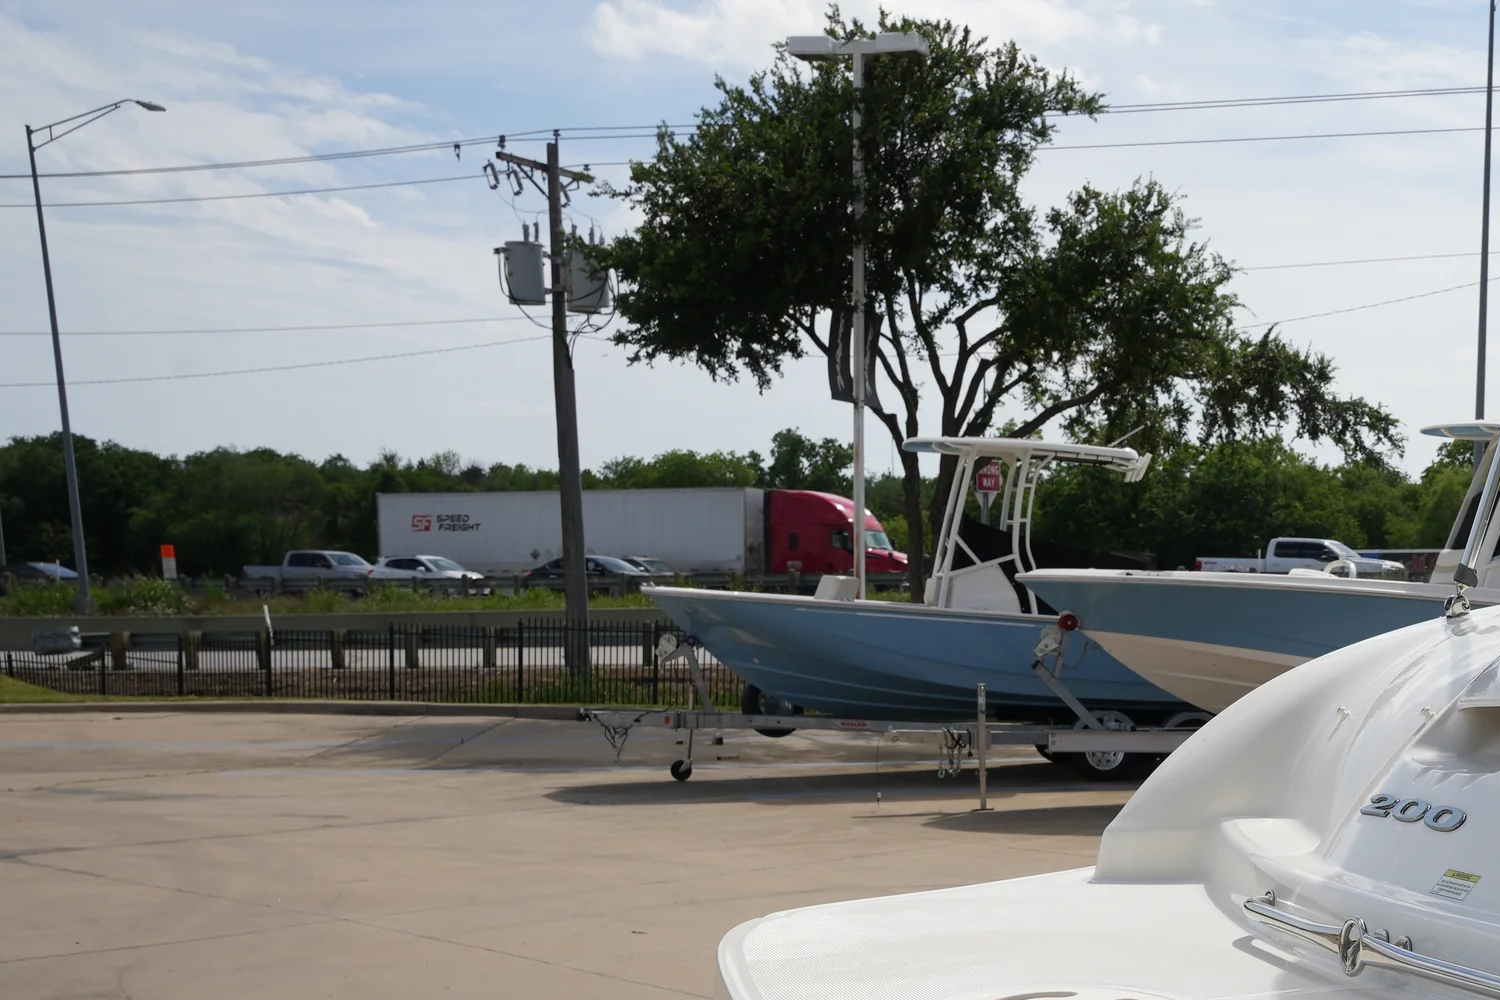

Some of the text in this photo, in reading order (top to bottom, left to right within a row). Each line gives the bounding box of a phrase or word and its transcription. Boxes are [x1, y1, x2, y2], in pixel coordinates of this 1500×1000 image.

[982, 477, 995, 488] WAY
[437, 514, 470, 523] SPEED
[438, 523, 481, 532] FREIGHT
[1360, 793, 1467, 832] 200
